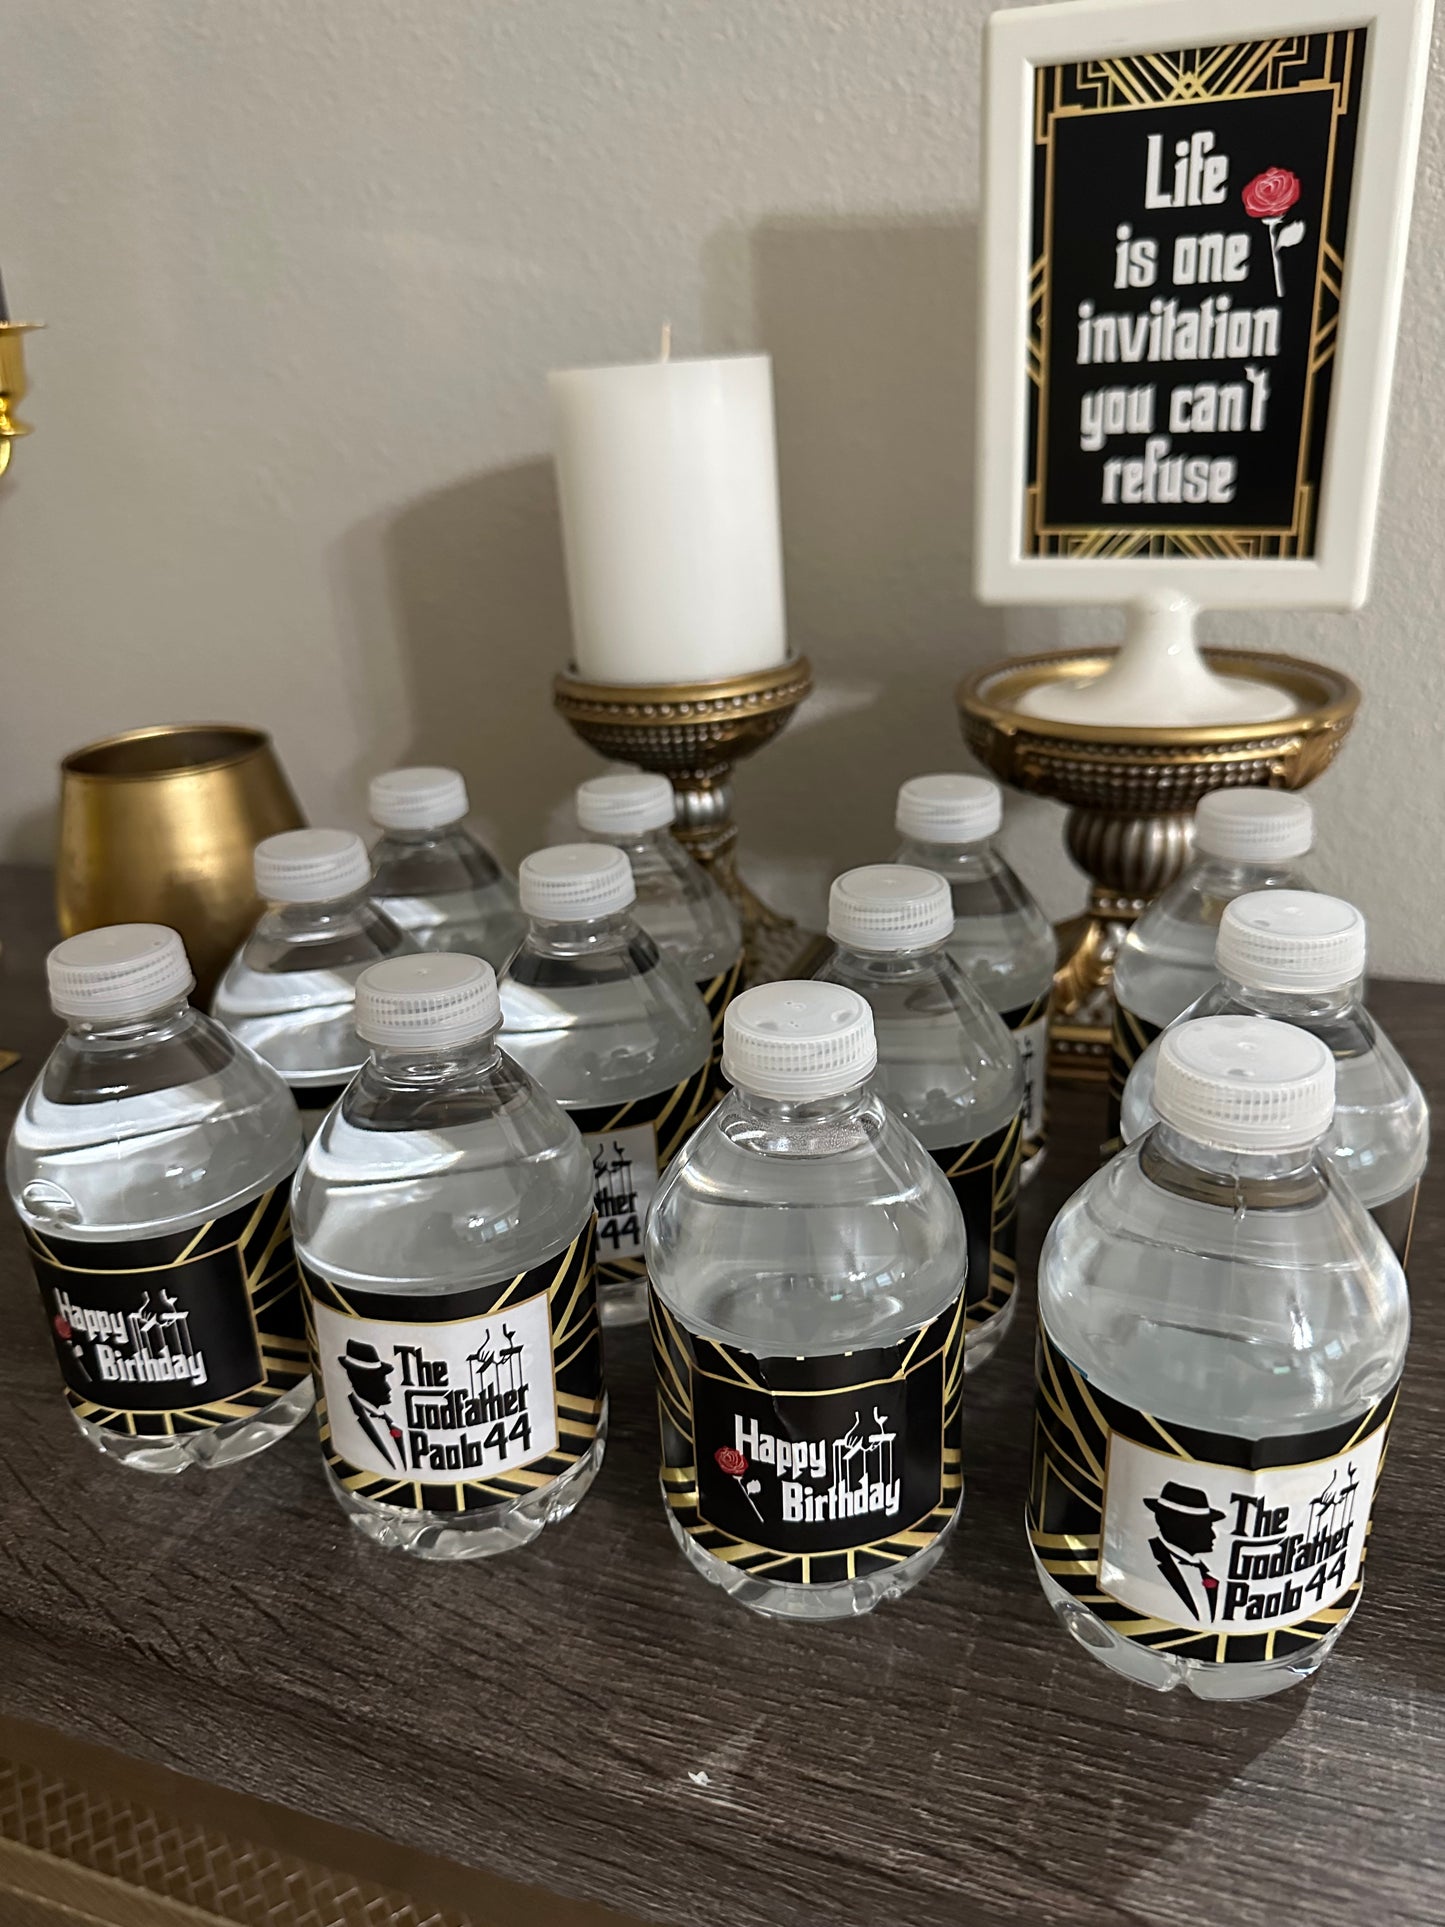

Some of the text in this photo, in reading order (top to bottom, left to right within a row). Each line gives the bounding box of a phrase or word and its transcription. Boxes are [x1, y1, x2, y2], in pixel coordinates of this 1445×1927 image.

[1144, 130, 1230, 210] Life
[1113, 222, 1250, 290] is one
[1076, 294, 1281, 365] invitation
[1079, 364, 1271, 452] you can't
[1101, 434, 1239, 504] refuse
[53, 1286, 130, 1344] Happy
[95, 1343, 208, 1387] Birthday
[393, 1344, 450, 1387] The
[404, 1382, 530, 1431] Godfather
[734, 1413, 827, 1480] Happy
[781, 1472, 900, 1523] Birthday
[1229, 1492, 1290, 1538] The
[1228, 1520, 1355, 1581] Godfather
